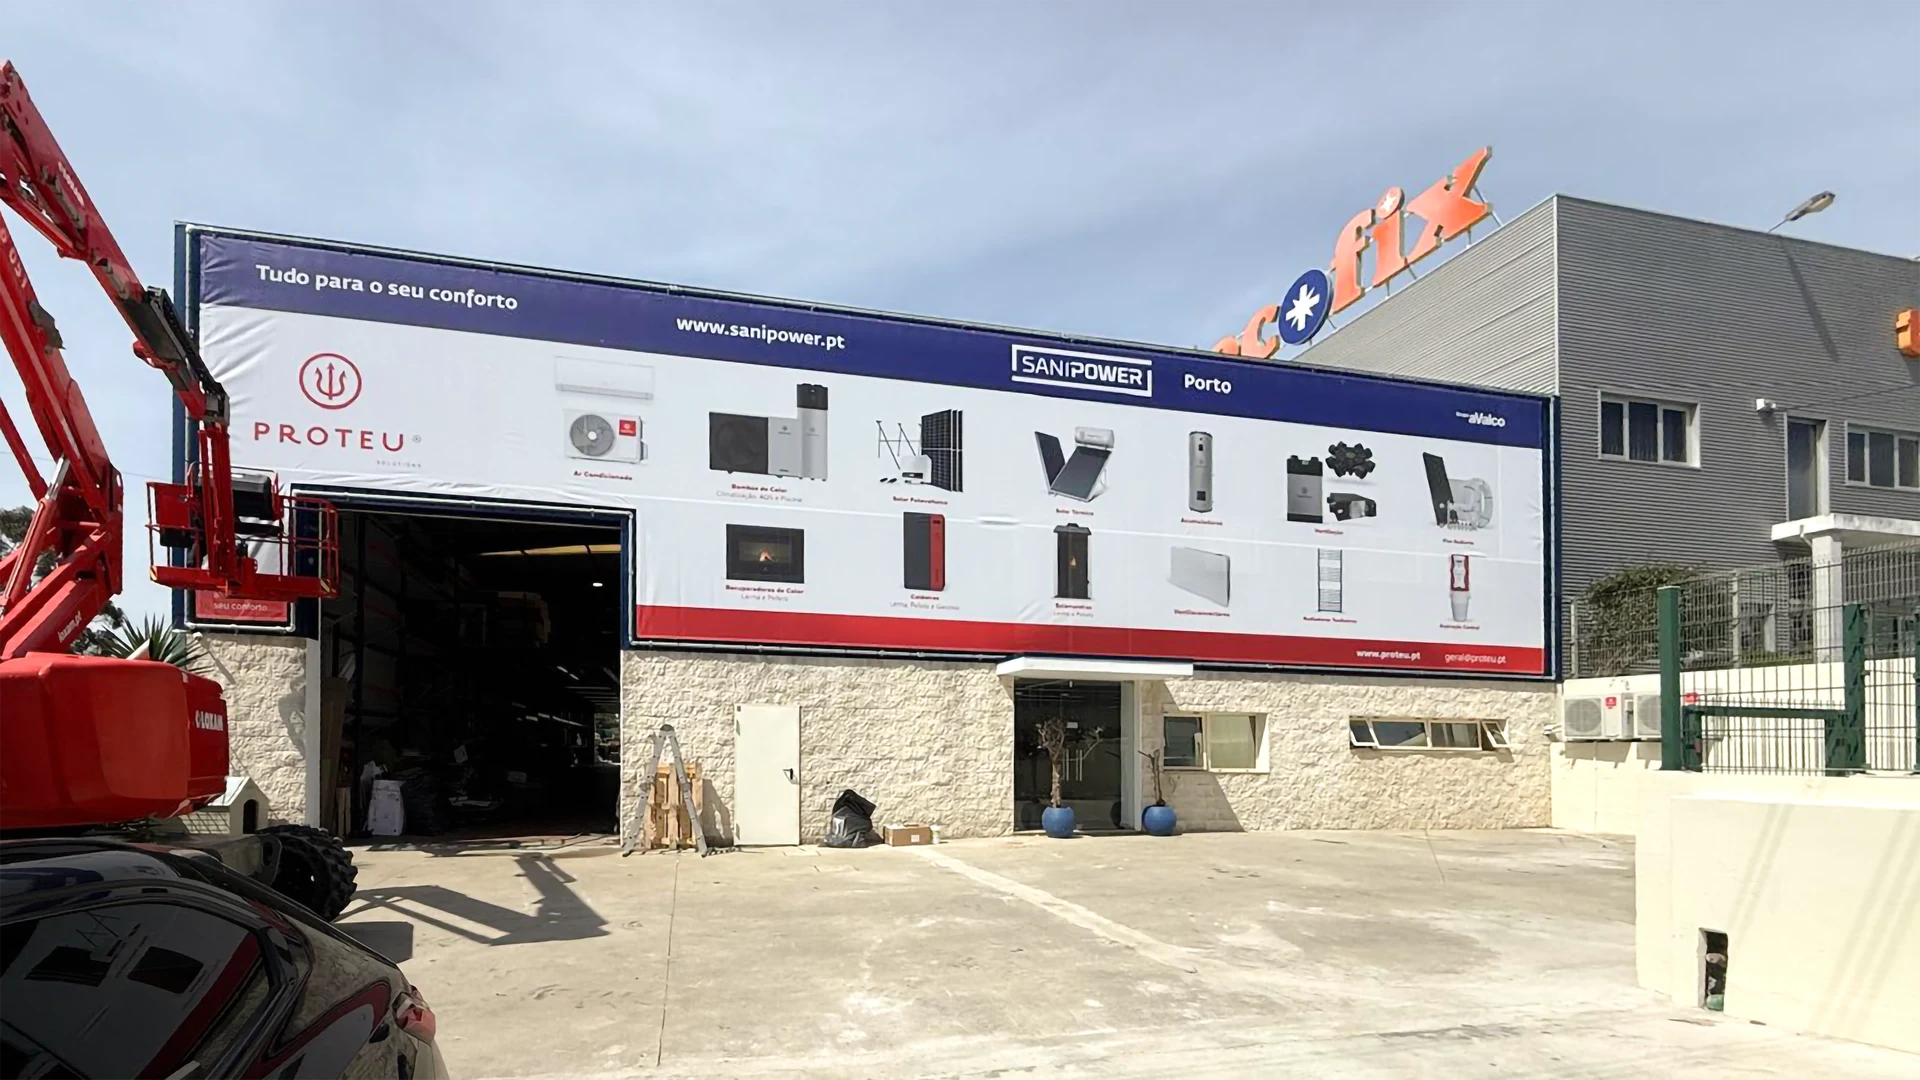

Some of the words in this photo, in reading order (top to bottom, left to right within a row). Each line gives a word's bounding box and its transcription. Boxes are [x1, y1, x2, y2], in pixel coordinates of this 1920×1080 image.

[255, 264, 310, 285] Tudo
[315, 273, 364, 291] para
[369, 281, 384, 294] o
[388, 283, 424, 299] seu
[429, 287, 518, 310] conforto
[676, 318, 846, 351] www.sanipower.pt
[1021, 355, 1143, 386] SANIPOWER
[1184, 373, 1233, 394] Porto
[254, 421, 404, 452] PROTEU
[1356, 650, 1421, 662] www.proteu.pt
